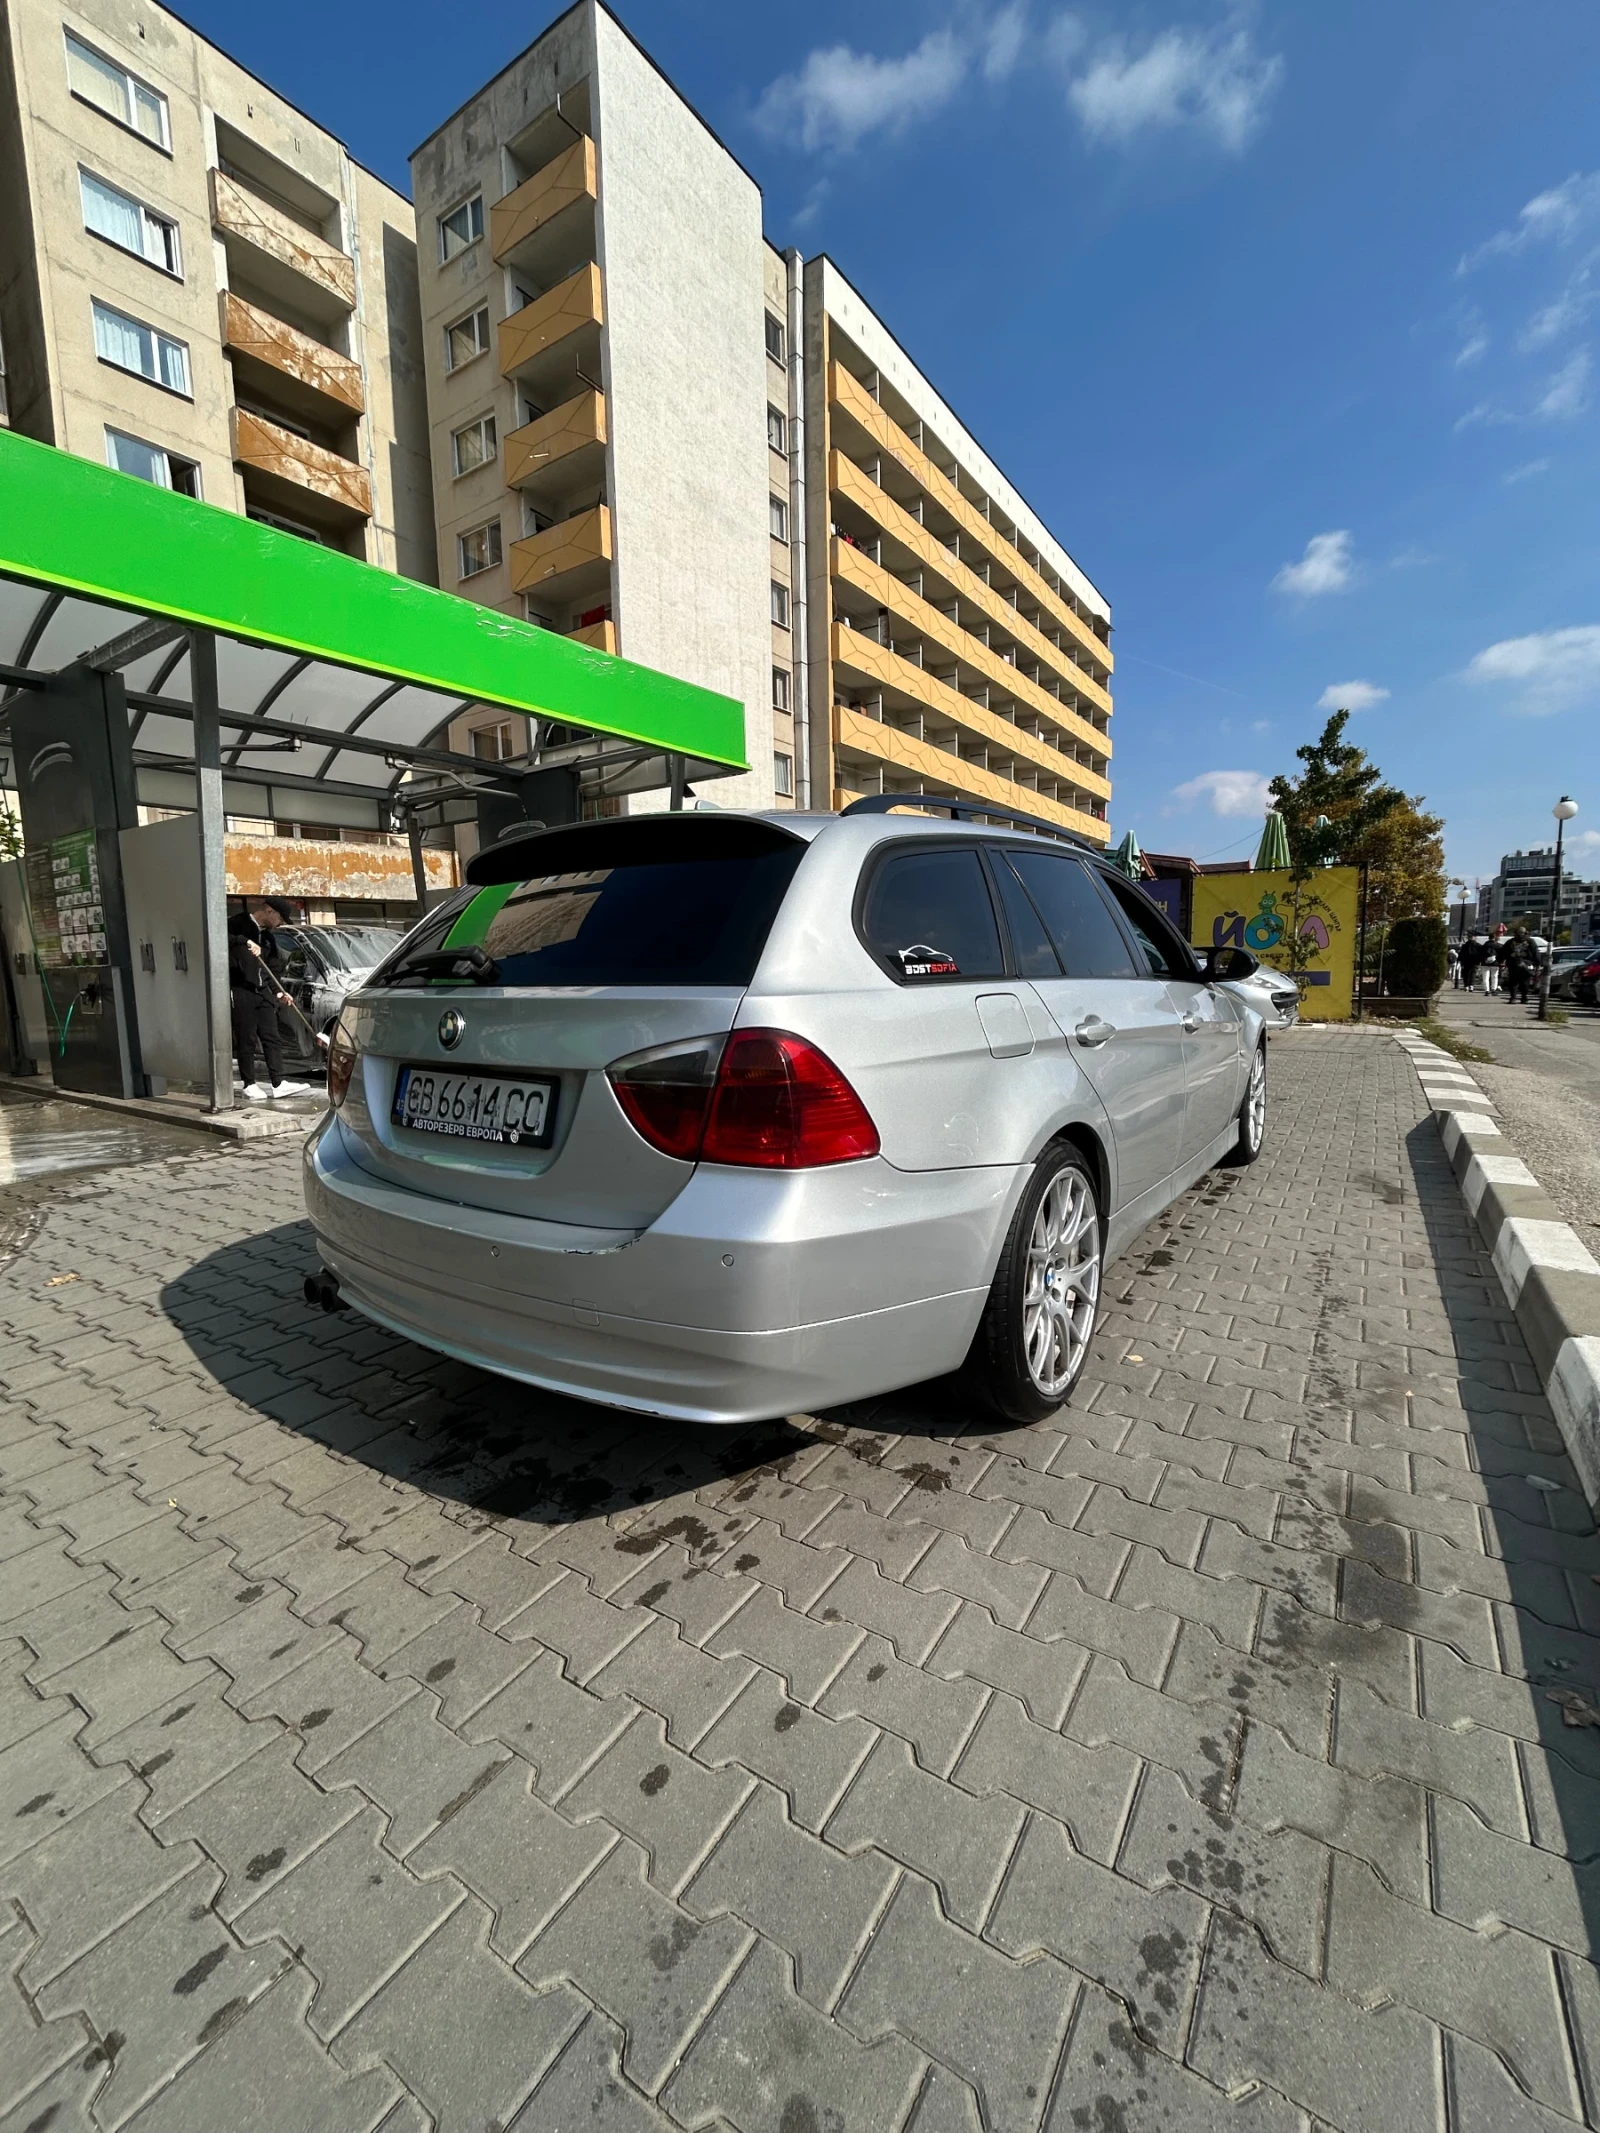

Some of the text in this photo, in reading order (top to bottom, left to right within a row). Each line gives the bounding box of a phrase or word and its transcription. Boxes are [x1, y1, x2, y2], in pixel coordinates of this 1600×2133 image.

[438, 1079, 501, 1127] 6614
[412, 1118, 503, 1142] АВТОРЕЗЕРВ ЕВРОПА
